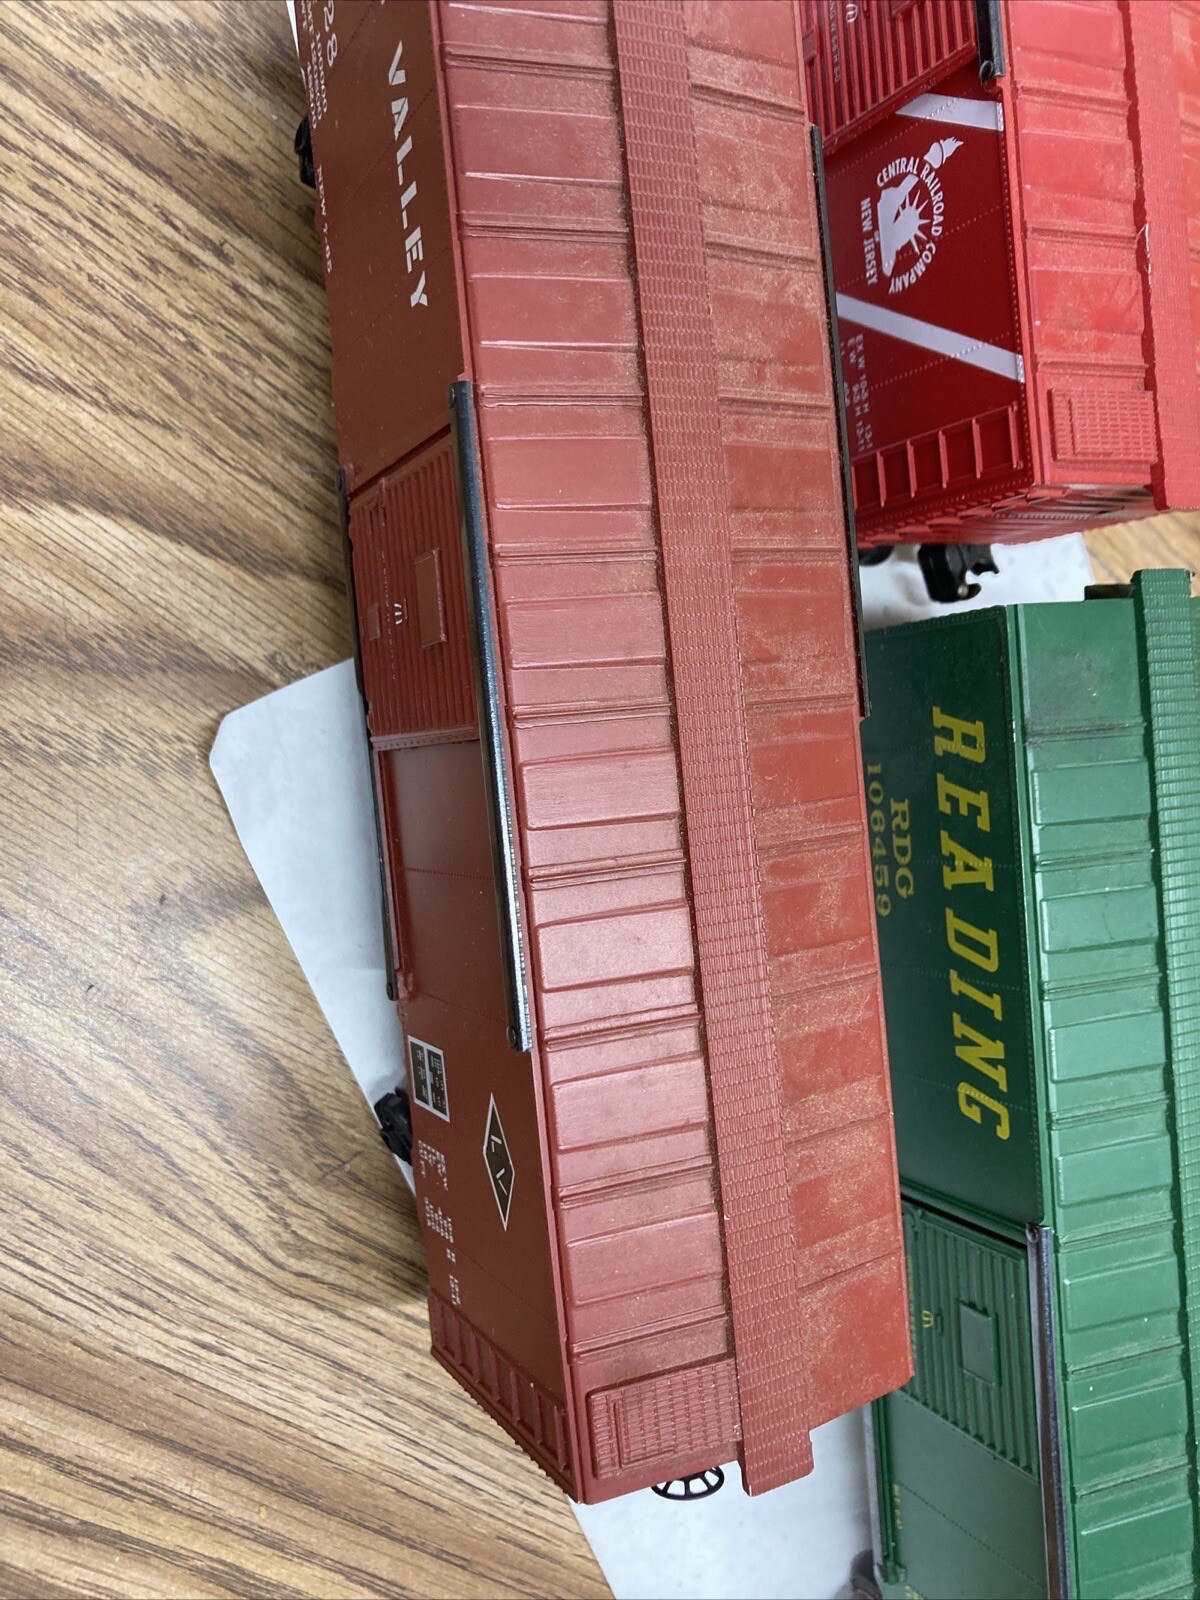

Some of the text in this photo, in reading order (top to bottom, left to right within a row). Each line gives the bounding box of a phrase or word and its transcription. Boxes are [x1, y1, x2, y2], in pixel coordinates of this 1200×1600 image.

[388, 40, 428, 307] VALLEY
[860, 197, 878, 285] NEW JERSEY
[876, 156, 945, 294] CENTRAL RAILROAD COMPANY
[866, 763, 892, 917] 106459
[890, 797, 914, 899] RDG
[932, 706, 1011, 1141] READING
